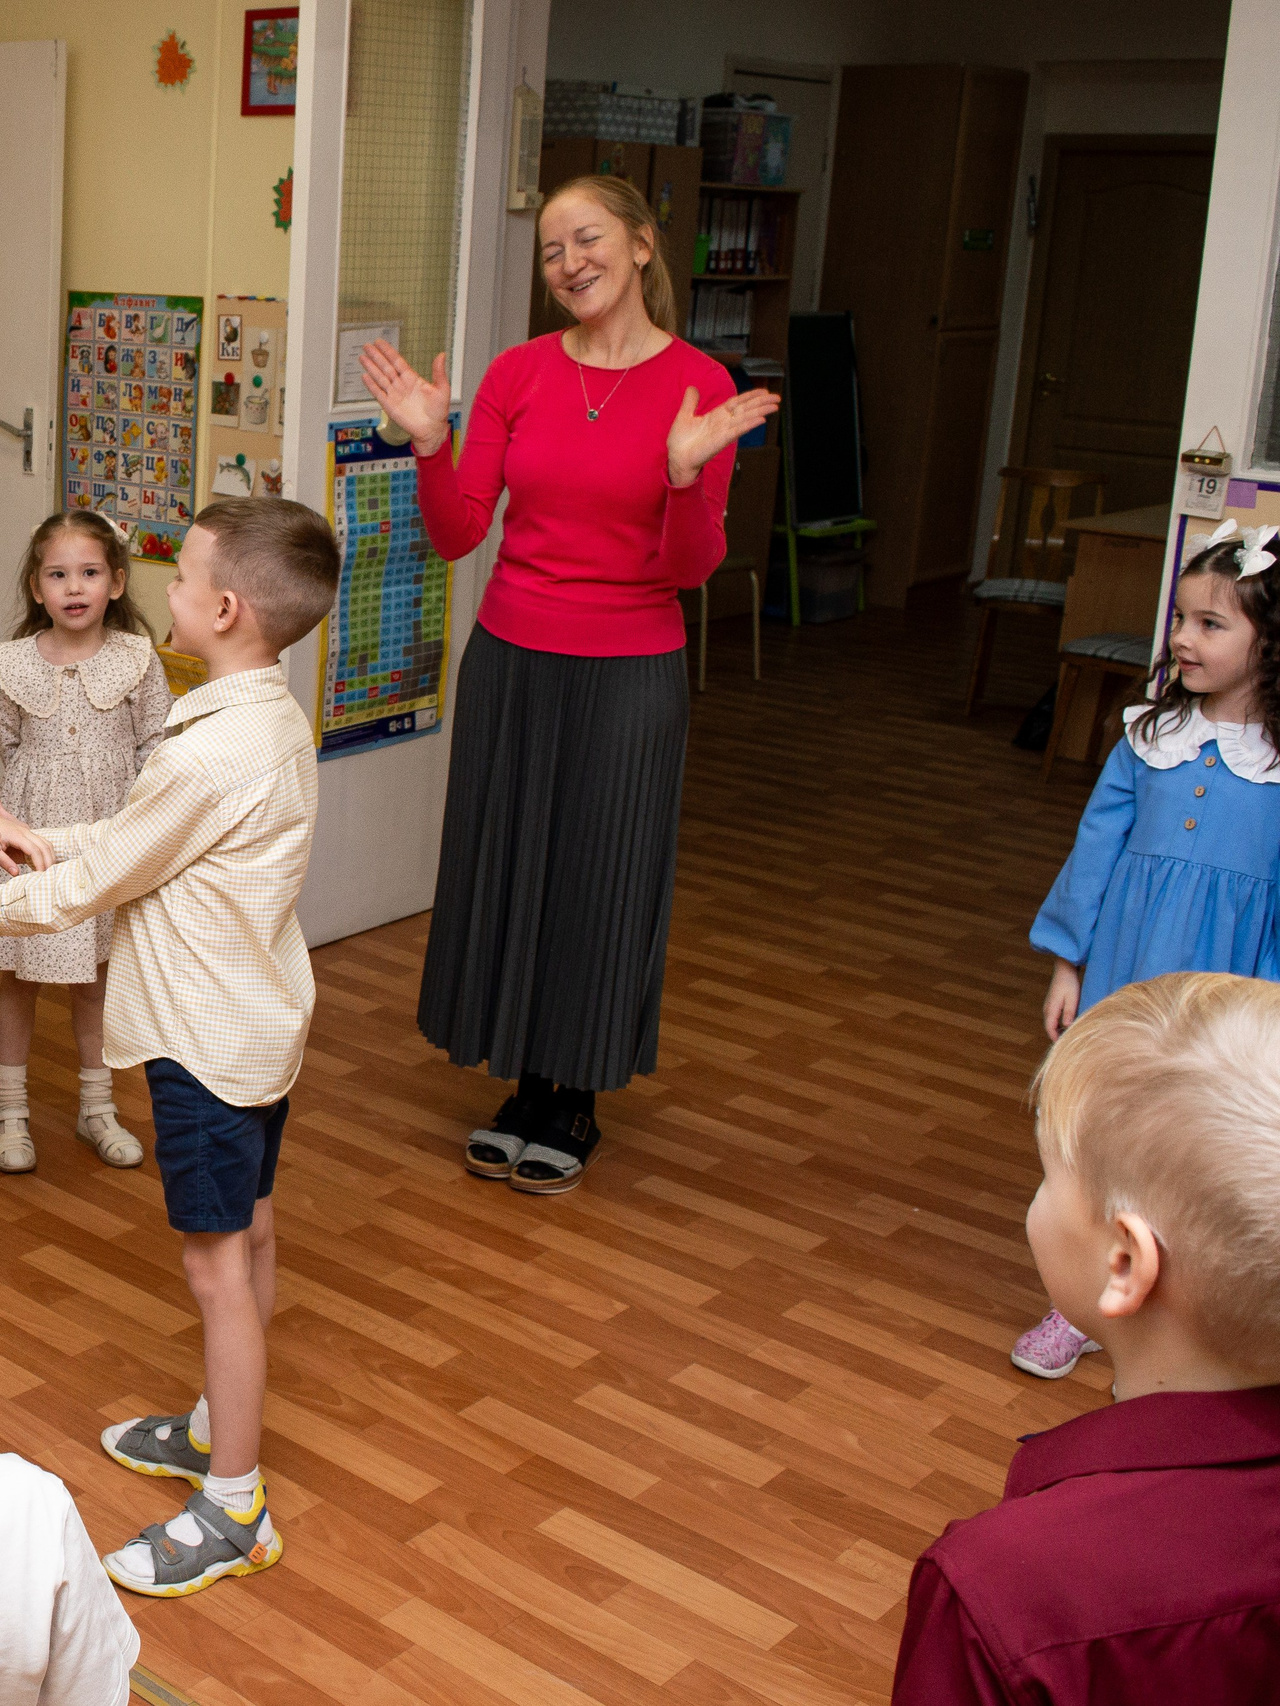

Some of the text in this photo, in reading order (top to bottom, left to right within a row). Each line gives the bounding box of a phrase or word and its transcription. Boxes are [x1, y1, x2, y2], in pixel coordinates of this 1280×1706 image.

[114, 295, 156, 309] Алфавит
[74, 312, 185, 333] А Б В Г Д
[70, 345, 79, 359] Е
[121, 348, 134, 363] Ж
[148, 350, 157, 364] З
[174, 352, 184, 367] И
[97, 381, 106, 395] К
[123, 382, 133, 397] Л
[148, 385, 158, 400] М
[173, 387, 183, 402] Н
[69, 413, 180, 438] О П Р С Т
[70, 447, 178, 474] У Ф Х Ц Ч
[1198, 477, 1217, 495] 19
[120, 487, 129, 501] Ъ
[143, 490, 155, 505] Ы
[170, 494, 178, 508] Ь
